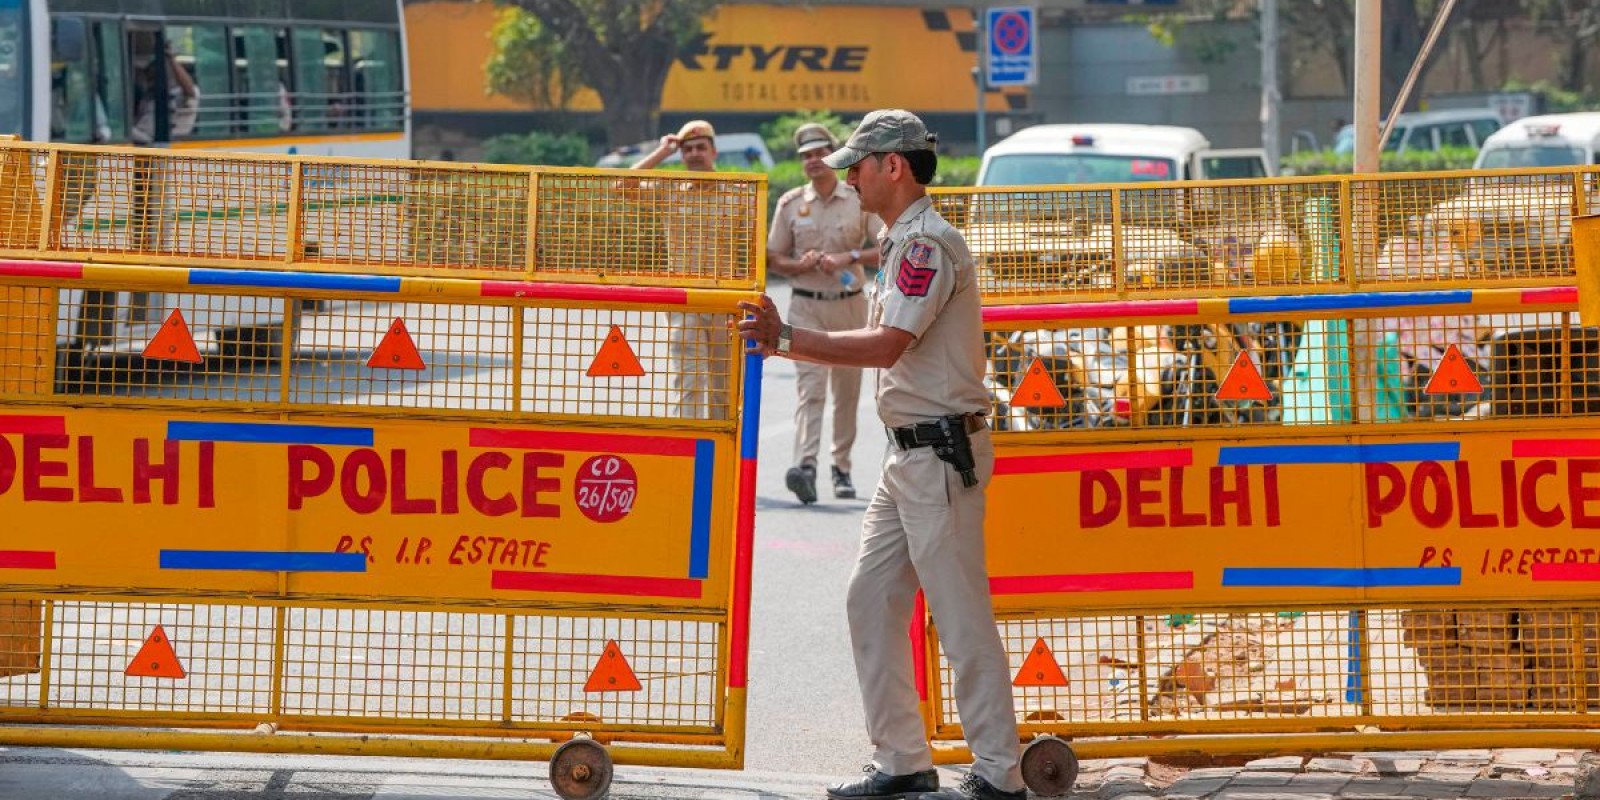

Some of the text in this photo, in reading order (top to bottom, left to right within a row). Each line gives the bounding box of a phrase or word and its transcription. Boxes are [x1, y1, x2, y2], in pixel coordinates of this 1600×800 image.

[721, 82, 870, 100] TOTAL CONTROL
[288, 444, 565, 518] POLICE
[592, 458, 620, 476] CD
[1080, 459, 1600, 528] DELHI POLICE
[395, 537, 432, 565] I.P.
[448, 535, 552, 568] ESTATE
